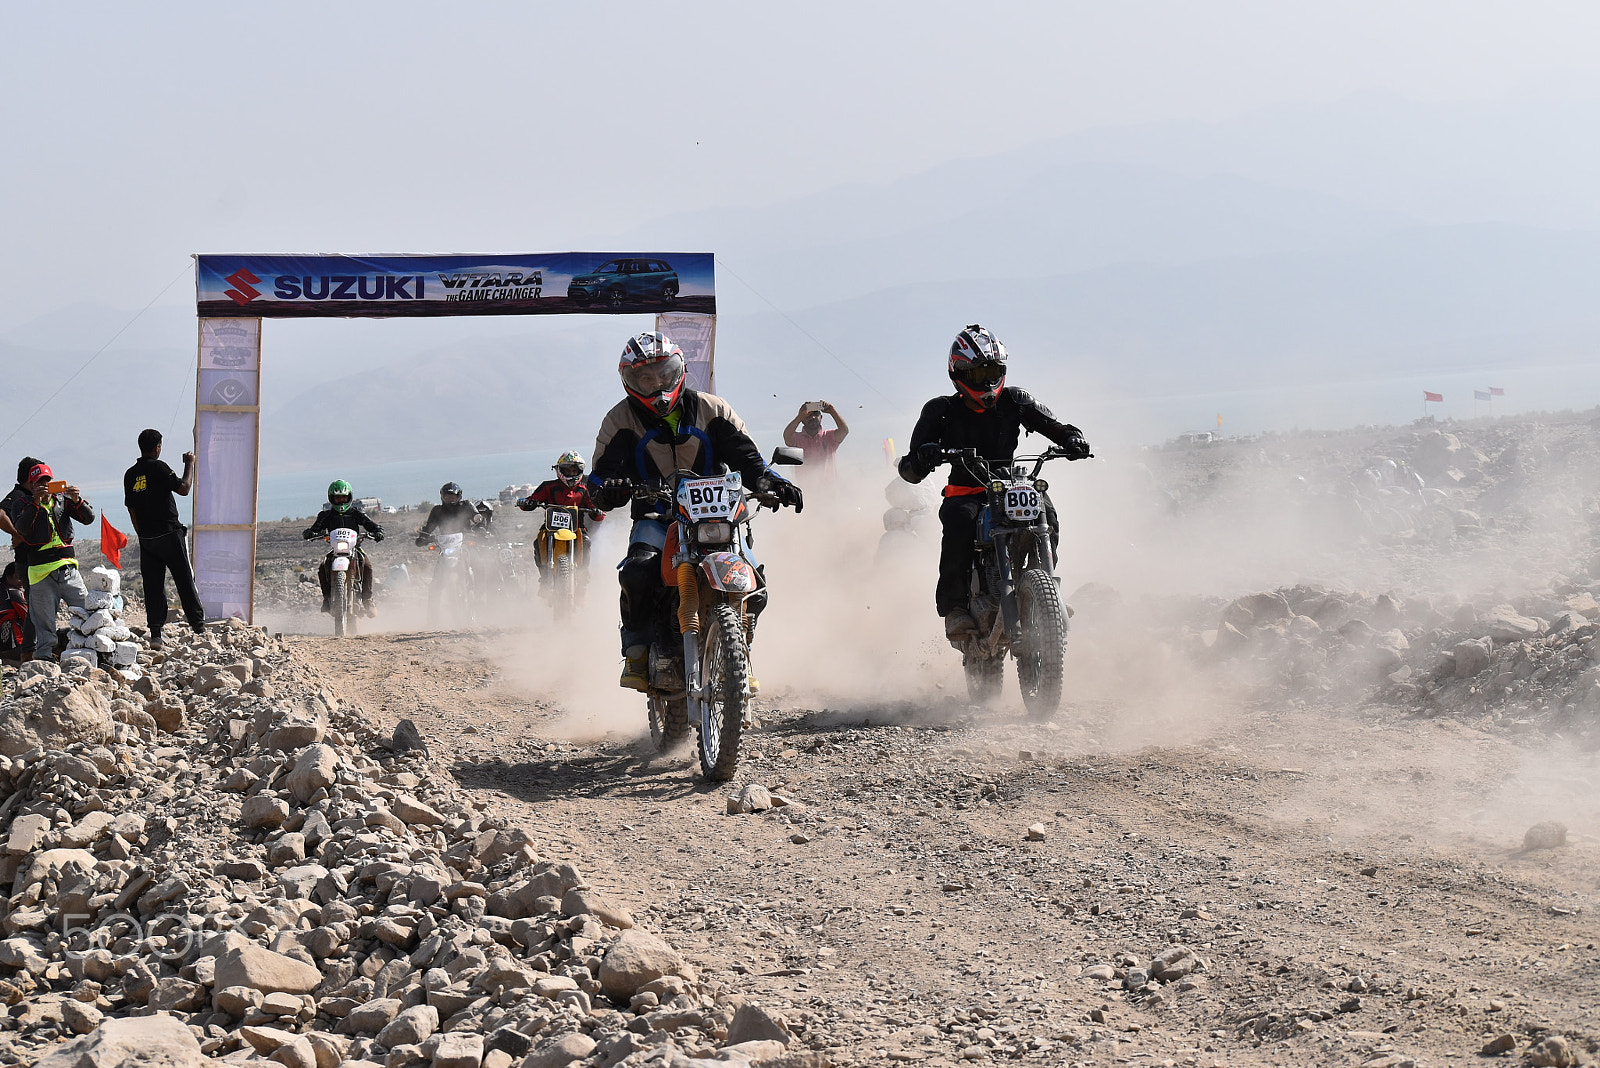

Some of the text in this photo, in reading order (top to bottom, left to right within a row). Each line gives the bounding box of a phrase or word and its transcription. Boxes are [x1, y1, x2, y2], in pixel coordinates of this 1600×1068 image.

[274, 275, 425, 300] SUZUKI
[438, 271, 543, 288] VITARA
[446, 294, 458, 302] THE
[690, 486, 724, 505] B07
[1008, 492, 1037, 507] B08
[554, 515, 569, 523] B06
